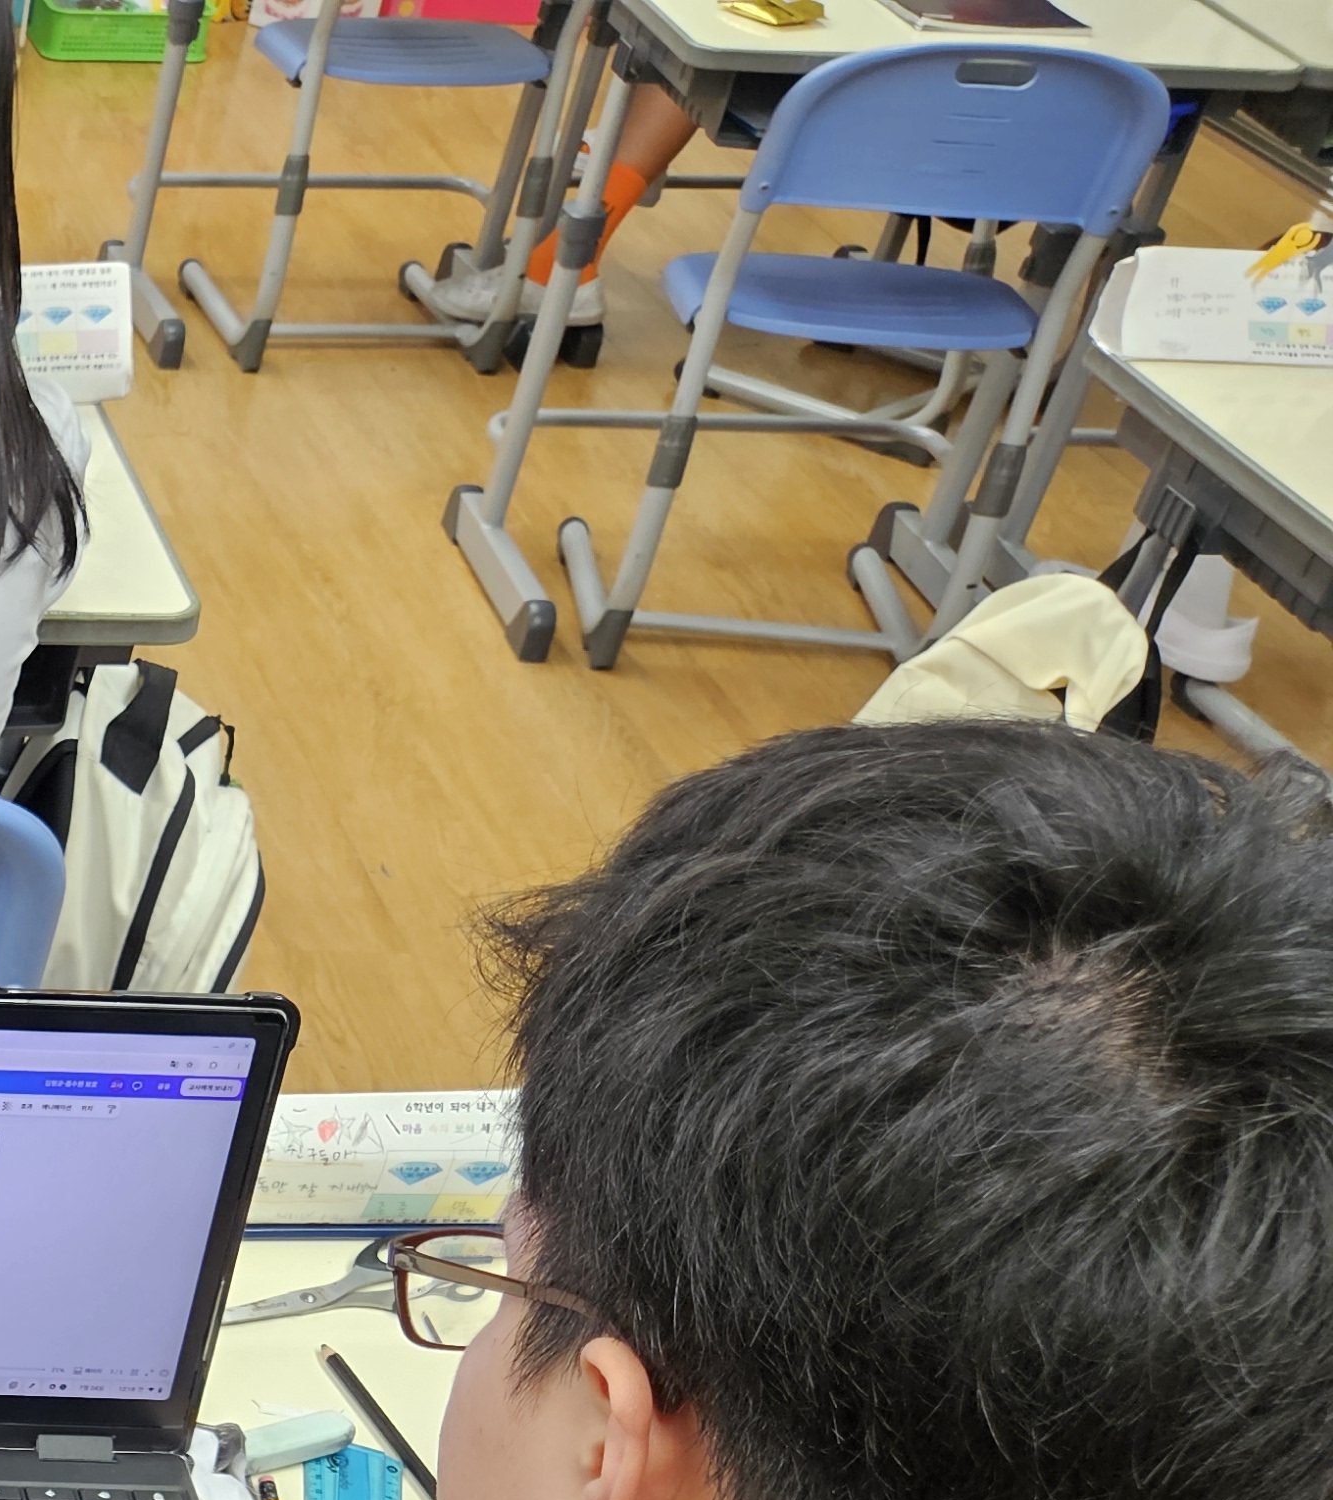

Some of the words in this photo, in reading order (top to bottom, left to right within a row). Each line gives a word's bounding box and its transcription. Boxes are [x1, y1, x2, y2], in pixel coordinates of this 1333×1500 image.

[405, 1101, 445, 1113] 6학년이
[450, 1101, 471, 1113] 되어
[402, 1123, 422, 1134] 마음
